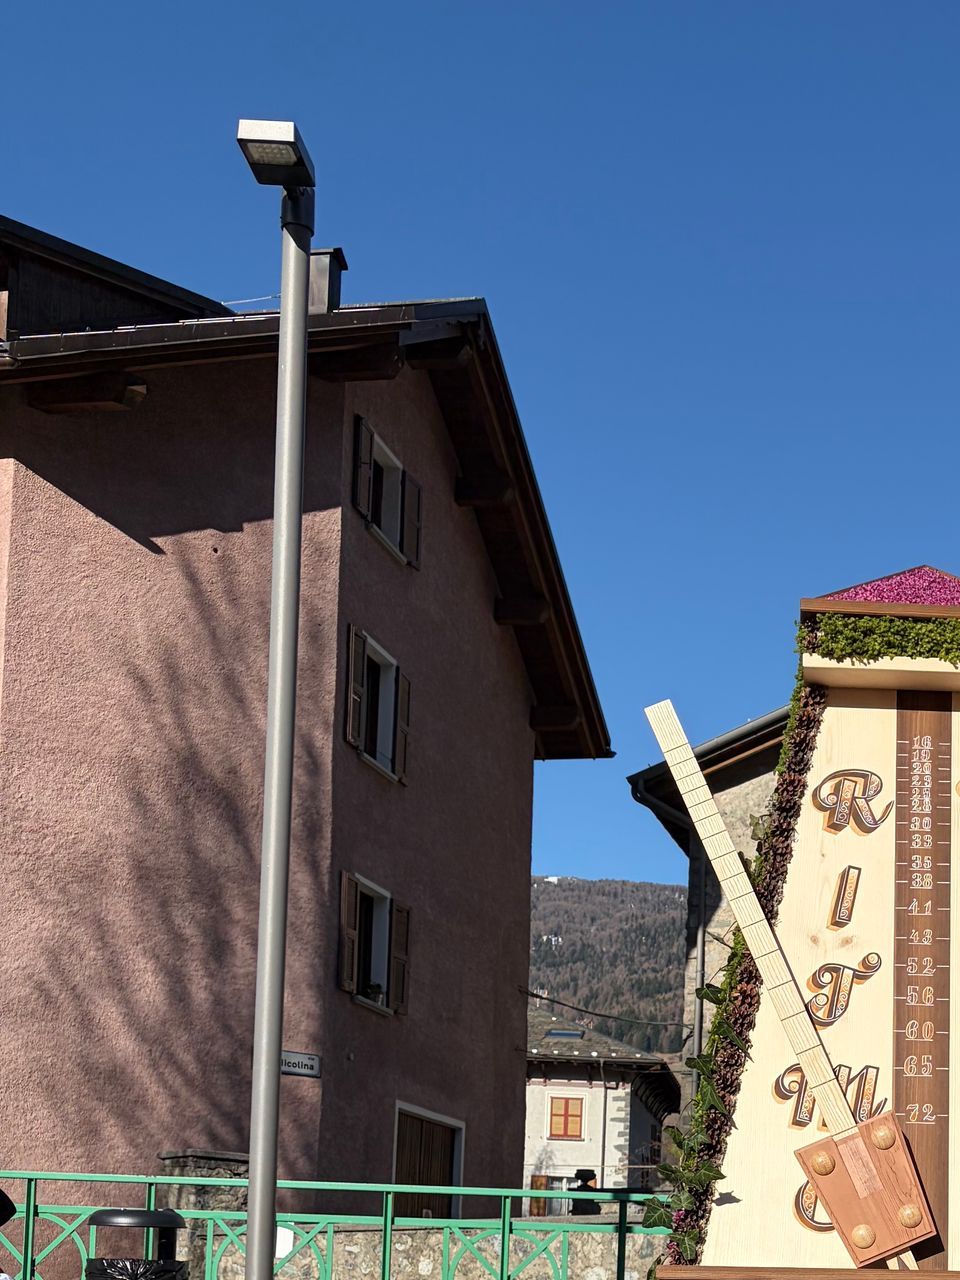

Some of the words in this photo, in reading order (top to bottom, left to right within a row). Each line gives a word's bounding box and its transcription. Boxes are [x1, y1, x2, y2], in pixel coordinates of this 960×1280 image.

[912, 762, 932, 774] 20
[911, 799, 932, 812] 28
[910, 816, 932, 829] 30
[911, 854, 932, 869] 35
[911, 872, 933, 887] 38
[908, 897, 932, 914] 41
[909, 928, 933, 943] 43
[906, 957, 936, 974] 52
[906, 985, 934, 1004] 56
[905, 1019, 935, 1039] 60
[281, 1059, 314, 1070] icolina
[903, 1055, 932, 1075] 65
[906, 1103, 936, 1121] 72
